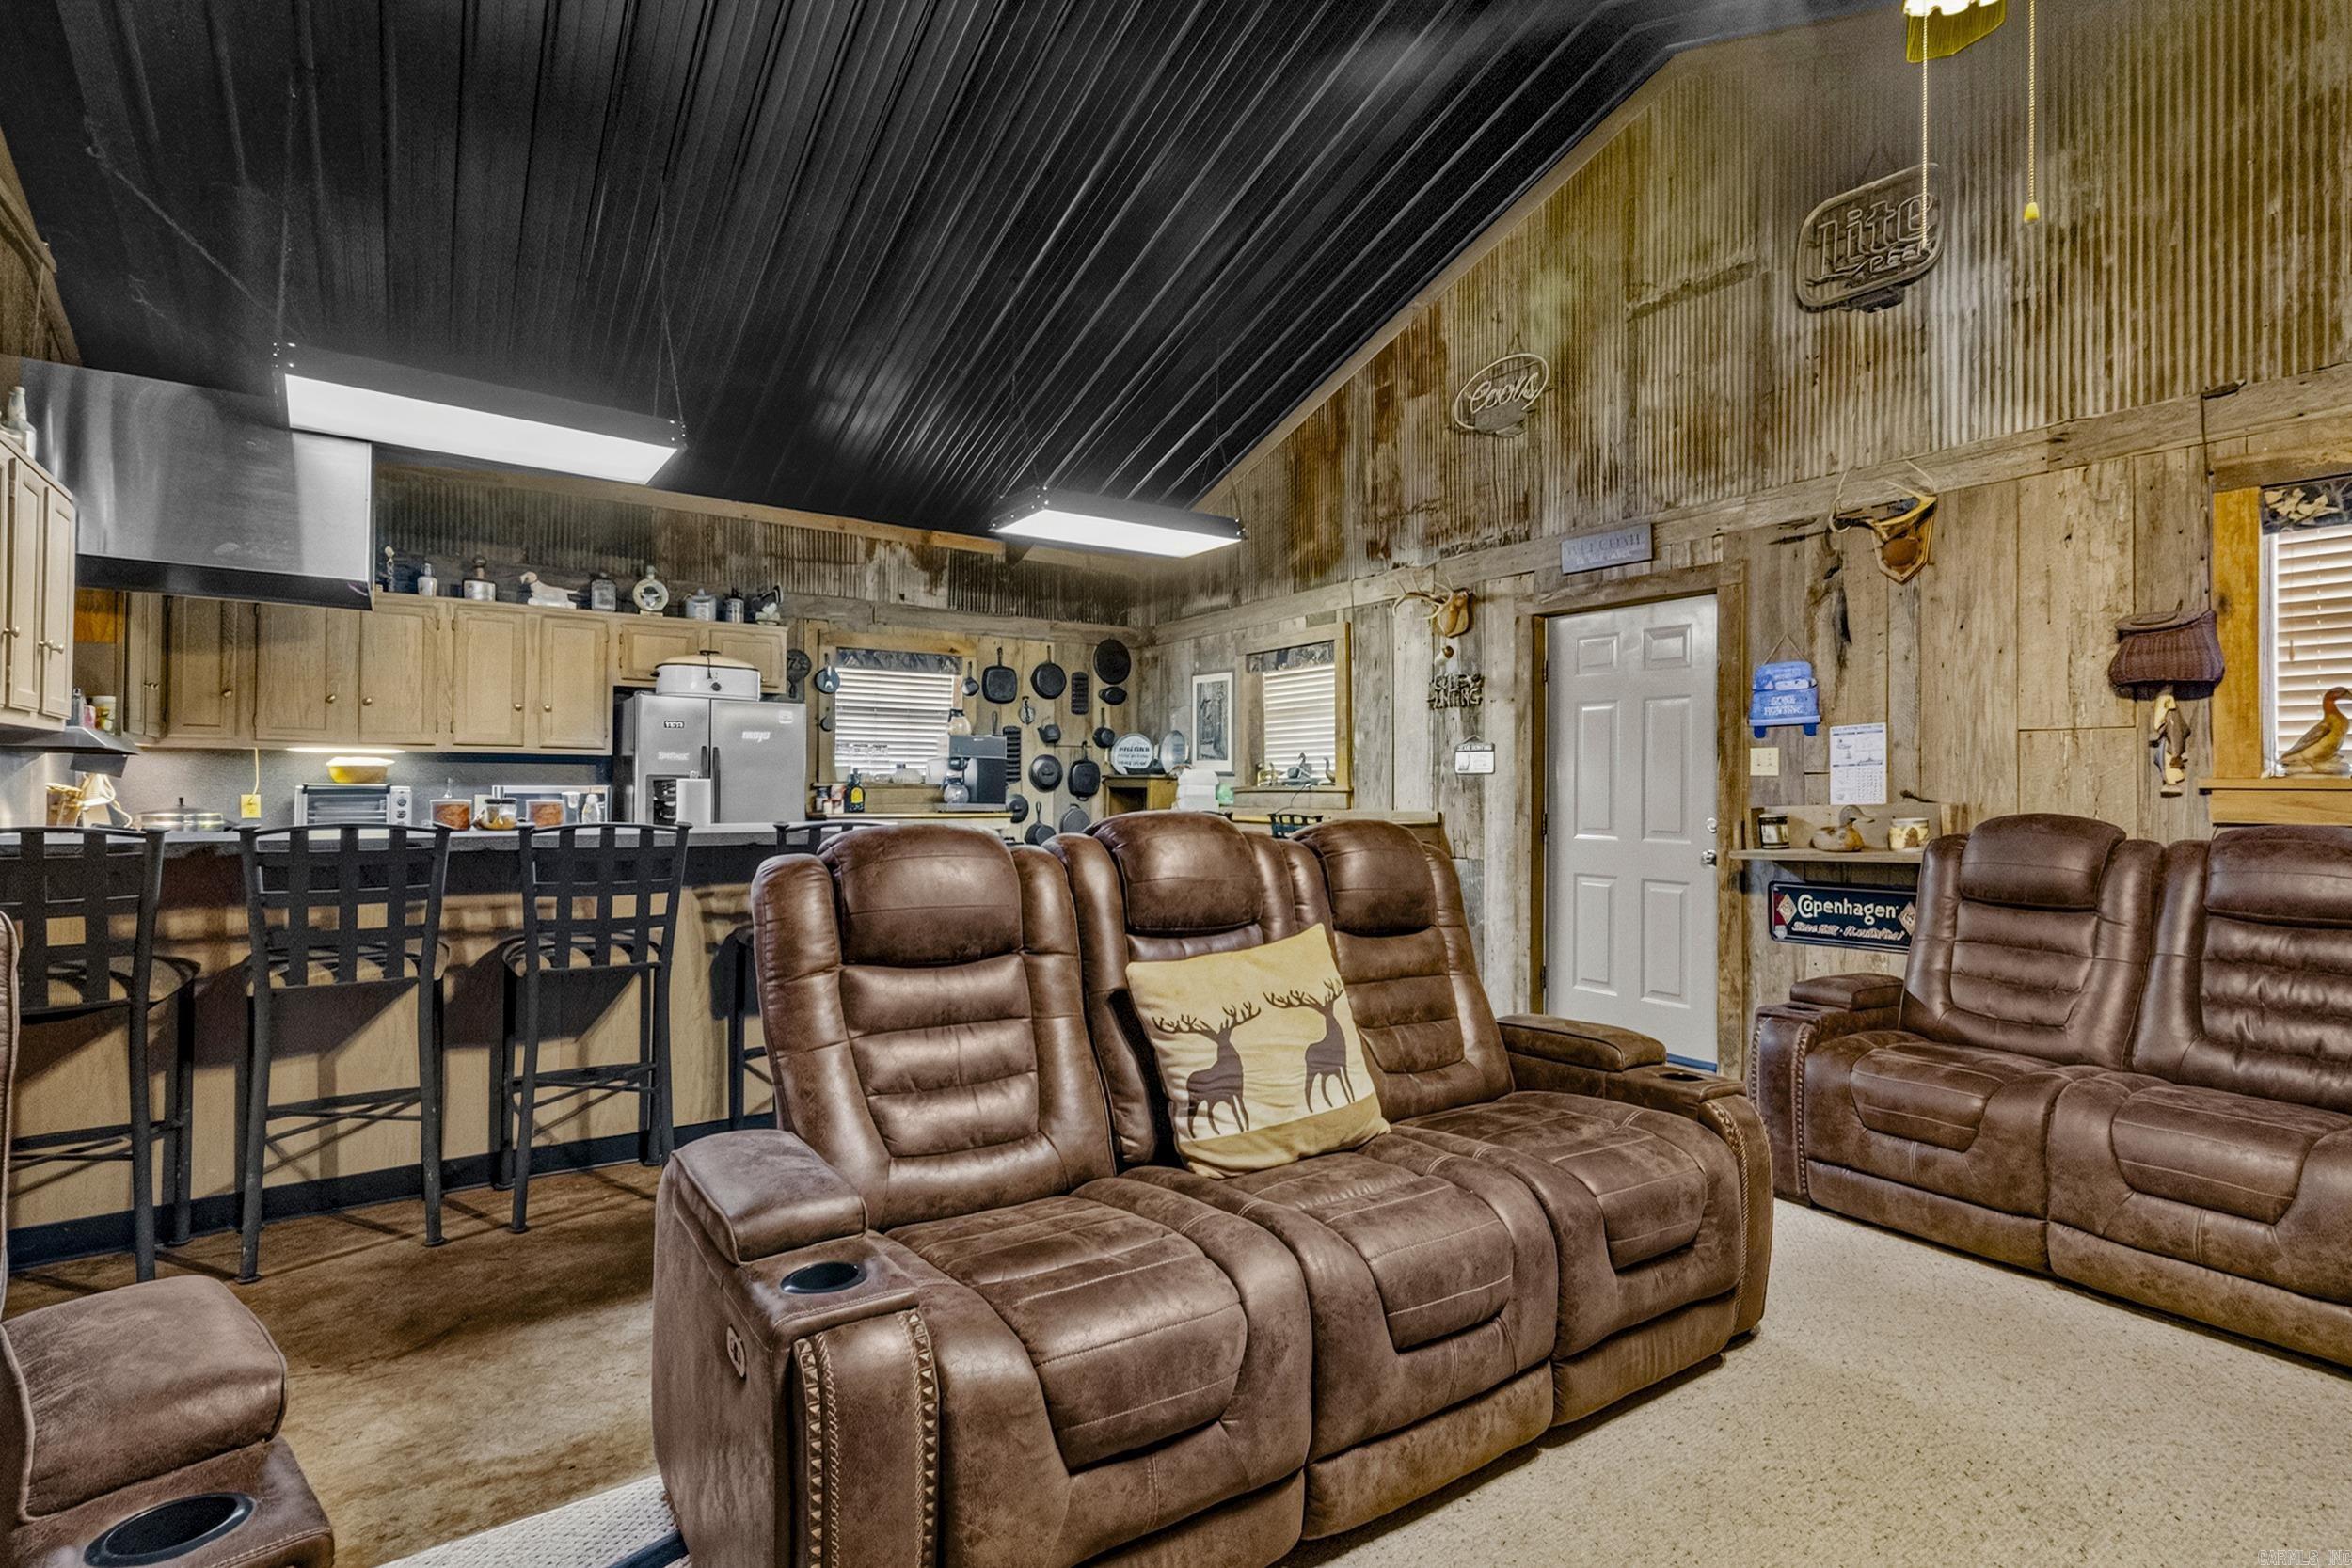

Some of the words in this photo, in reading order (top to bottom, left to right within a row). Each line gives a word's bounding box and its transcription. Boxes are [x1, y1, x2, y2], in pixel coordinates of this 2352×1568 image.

[1818, 194, 1933, 278] Lite
[1470, 372, 1539, 414] Coors
[1798, 894, 1897, 925] Copenhagen
